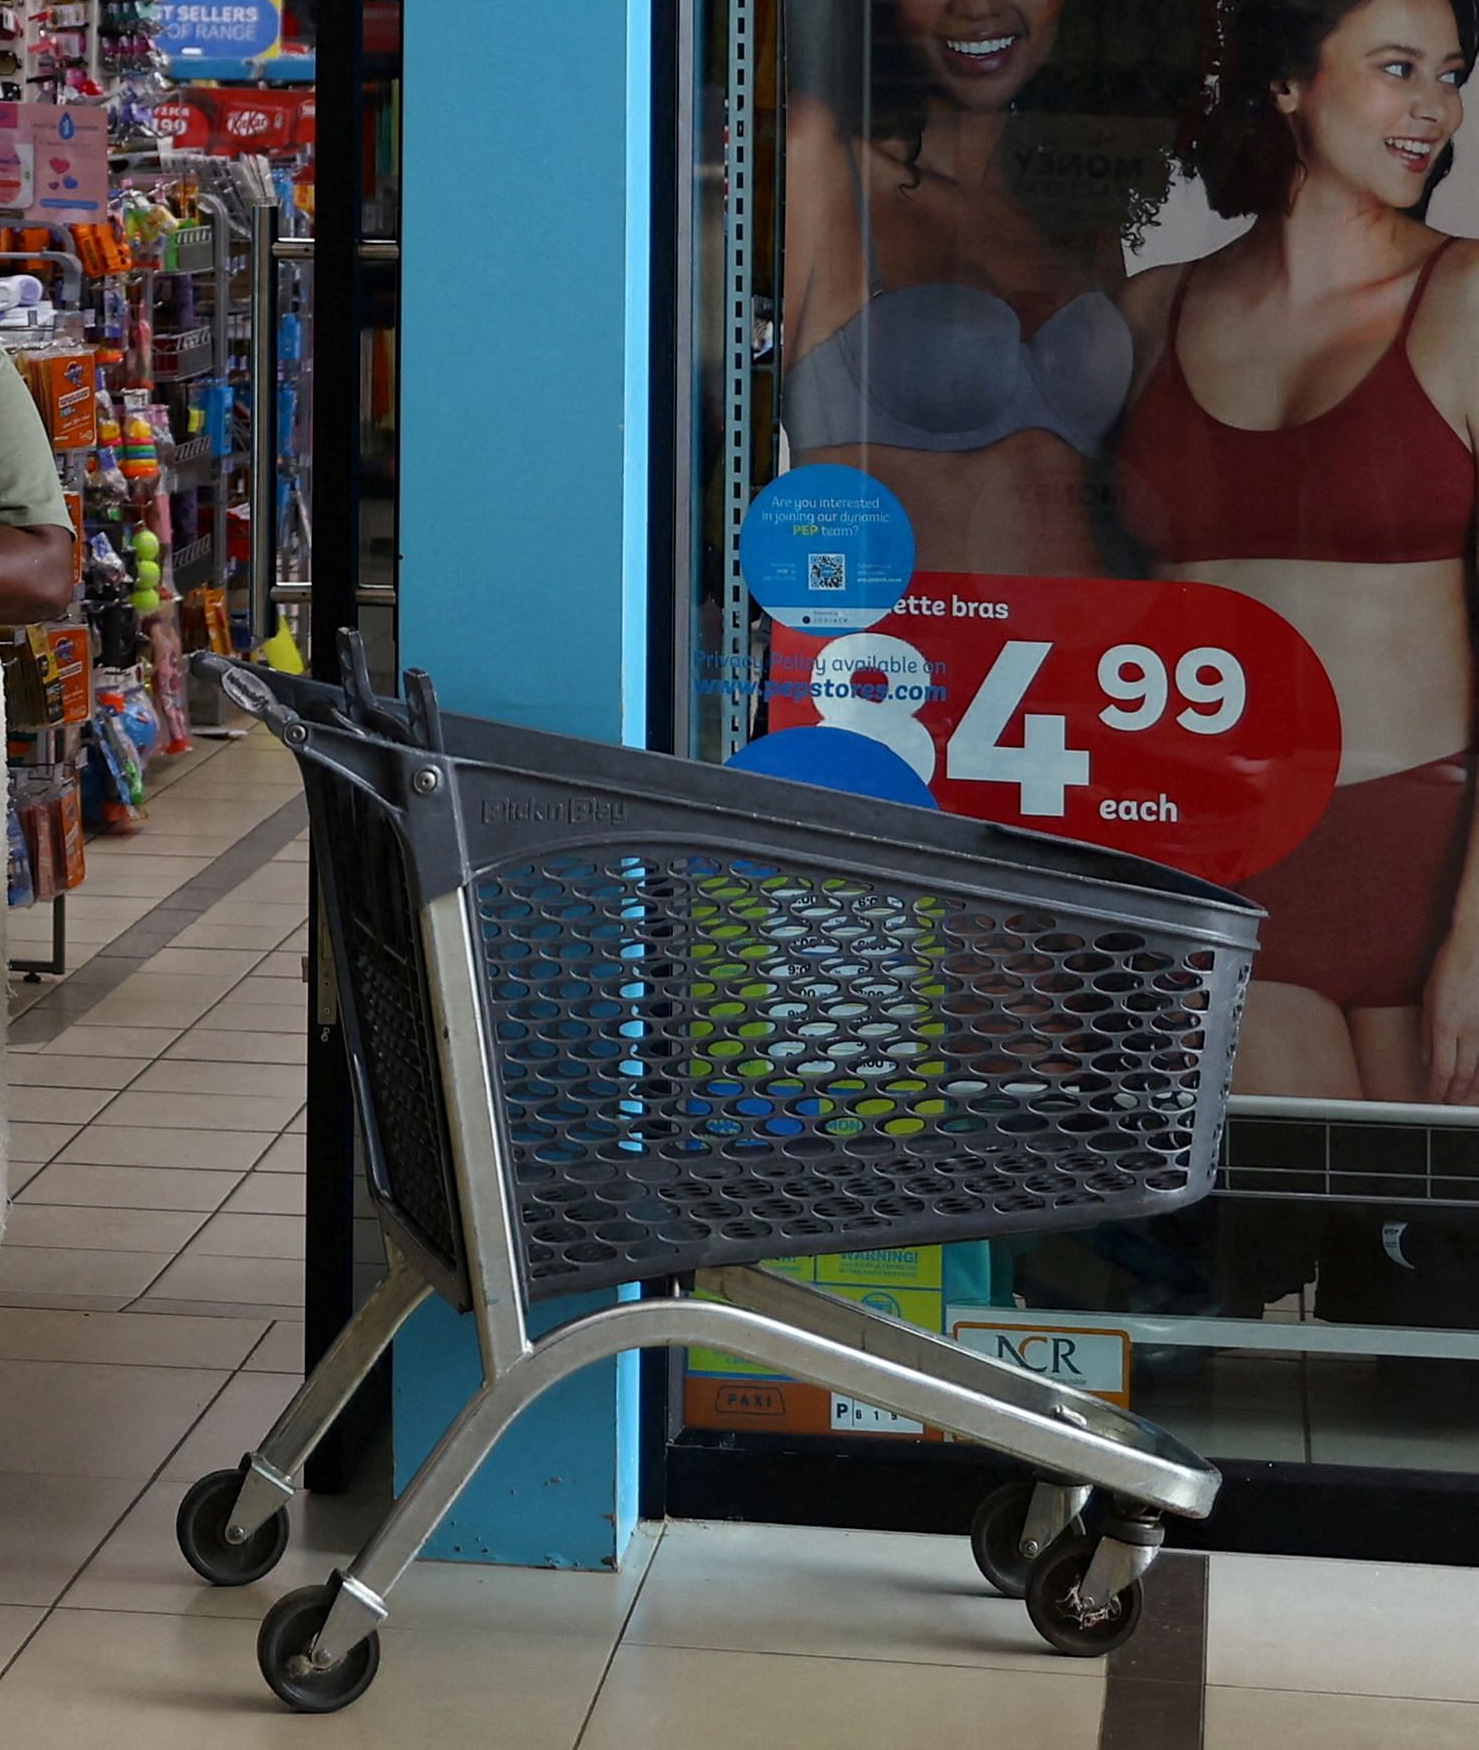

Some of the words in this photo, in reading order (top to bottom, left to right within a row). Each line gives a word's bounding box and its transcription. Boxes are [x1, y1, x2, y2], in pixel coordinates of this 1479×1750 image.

[177, 6, 258, 23] SELLERS
[168, 23, 190, 40] OF
[195, 24, 257, 41] RANGE
[771, 496, 792, 508] Are
[795, 499, 816, 512] you
[819, 497, 880, 509] interested
[774, 511, 815, 525] joining
[817, 513, 836, 522] our
[839, 511, 890, 525] dynamic
[793, 525, 818, 536] PEP
[821, 525, 859, 537] team?
[892, 597, 946, 617] ette
[951, 594, 1010, 620] bras
[693, 652, 762, 674] Privacy
[772, 654, 826, 675] Policy
[831, 654, 918, 674] available
[923, 660, 947, 675] on
[692, 678, 948, 704] www.pepstores.com
[1098, 793, 1179, 823] each
[996, 1334, 1083, 1375] NCR
[728, 1393, 772, 1407] PAXI
[836, 1402, 849, 1419] P
